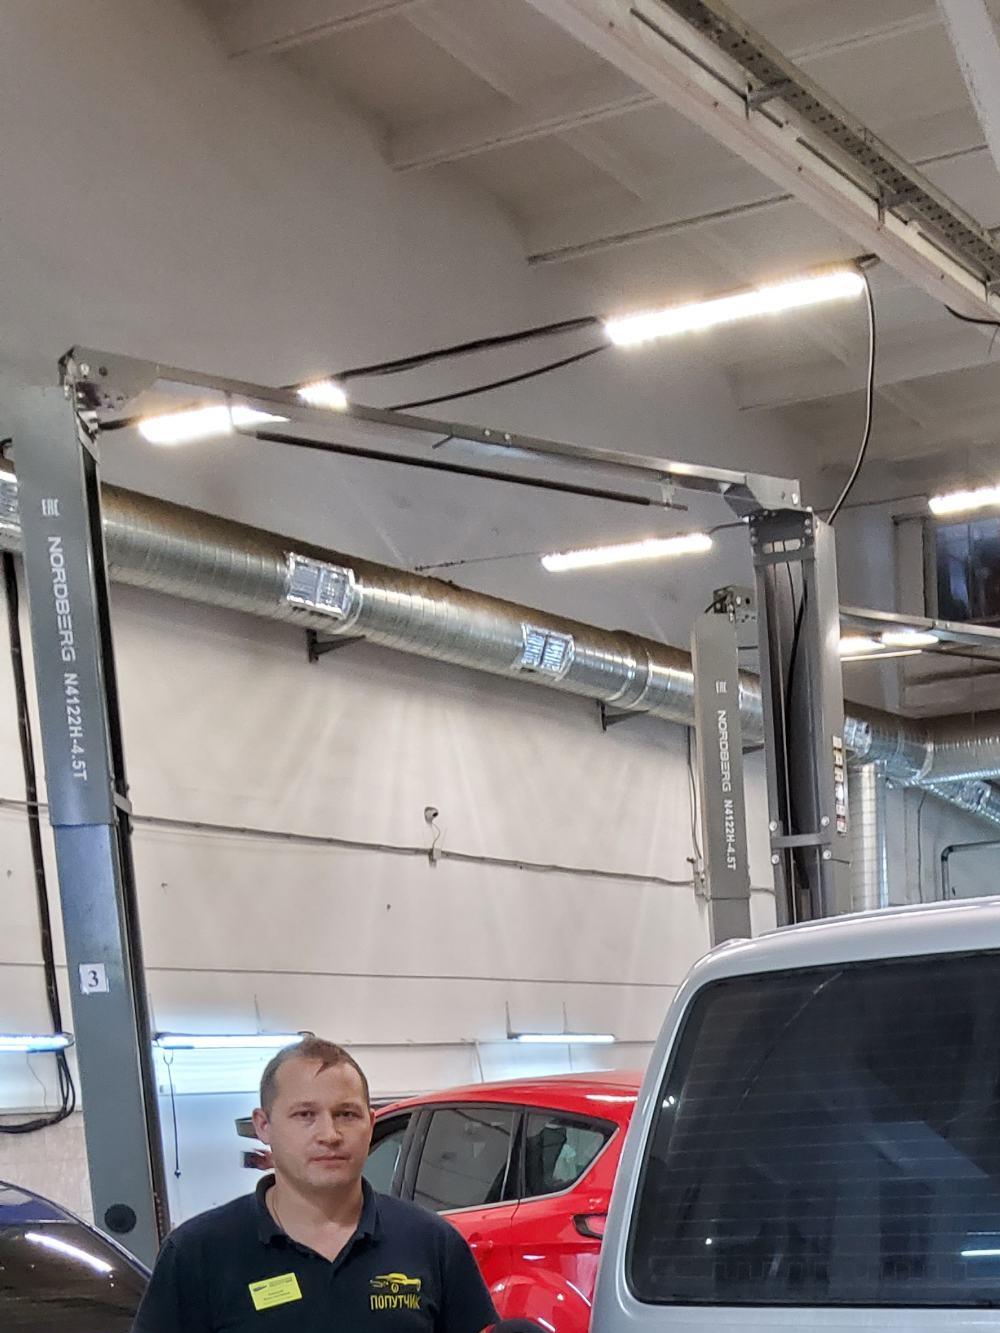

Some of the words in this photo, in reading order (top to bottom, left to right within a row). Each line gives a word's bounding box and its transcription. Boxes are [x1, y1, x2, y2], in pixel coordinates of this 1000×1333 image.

[48, 536, 76, 662] NORDBERG
[64, 672, 88, 780] N4122H-4.5T
[717, 710, 732, 792] NORDBERG
[88, 970, 99, 988] 3
[370, 1294, 421, 1311] ПОПУТЧИК
